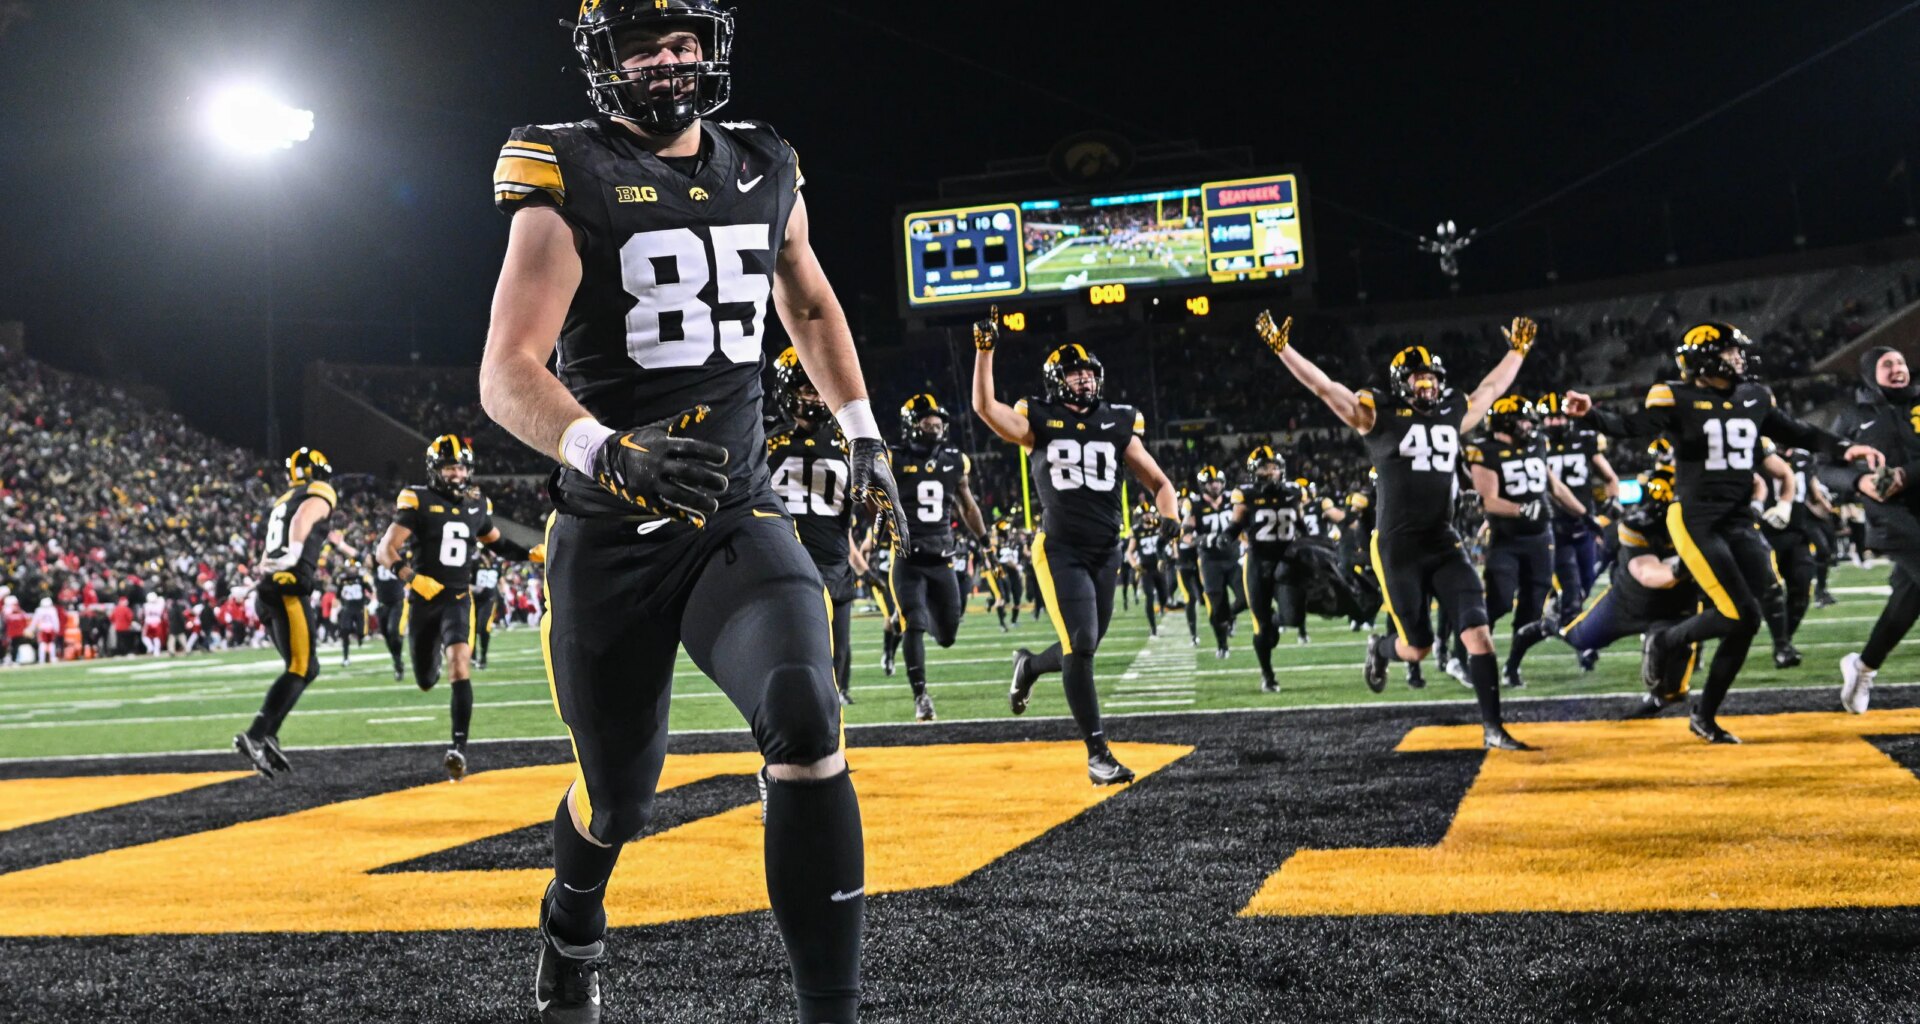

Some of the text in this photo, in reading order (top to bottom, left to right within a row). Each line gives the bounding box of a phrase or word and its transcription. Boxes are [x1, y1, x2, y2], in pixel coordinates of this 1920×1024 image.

[619, 223, 770, 369] 85
[1186, 296, 1209, 316] 40
[1003, 313, 1025, 332] 40
[1046, 438, 1117, 492] 80
[1399, 423, 1459, 473] 49
[1703, 417, 1757, 471] 19
[770, 456, 850, 517] 40
[1500, 457, 1548, 497] 59
[916, 480, 944, 523] 9
[1255, 507, 1297, 542] 28
[439, 521, 470, 567] 6
